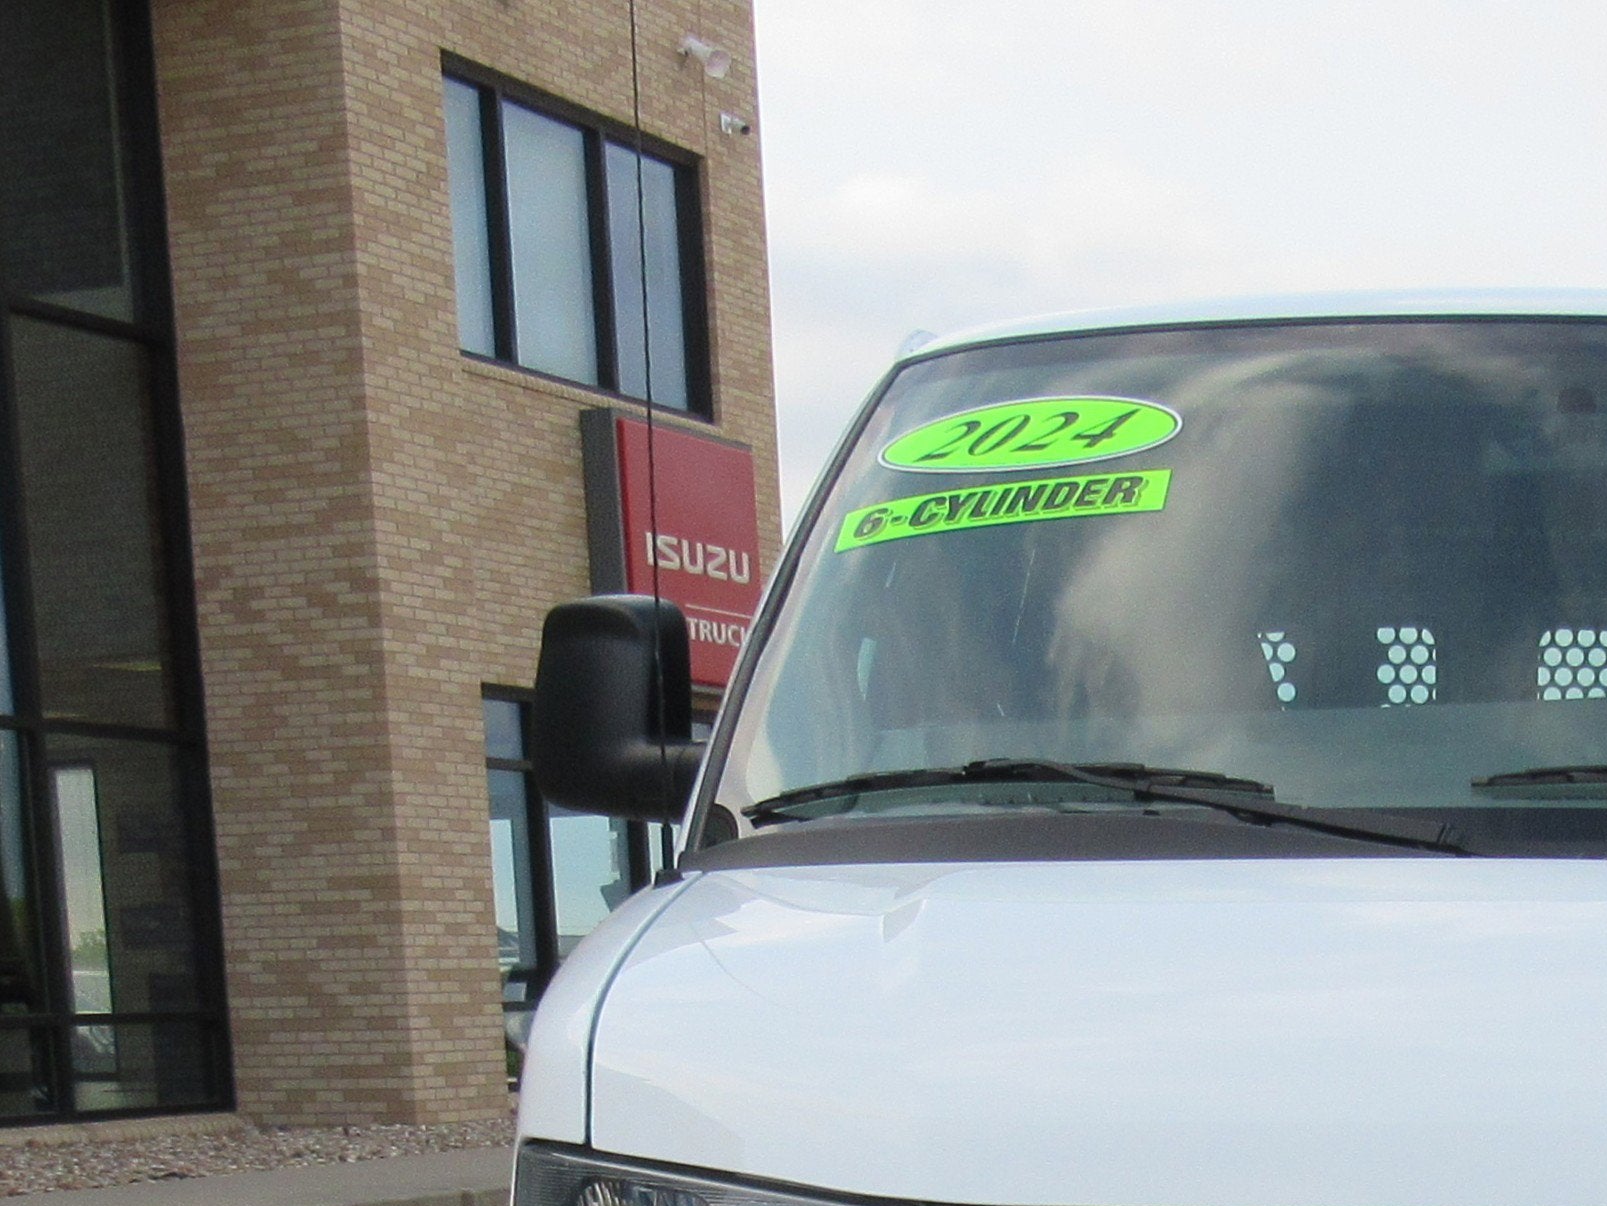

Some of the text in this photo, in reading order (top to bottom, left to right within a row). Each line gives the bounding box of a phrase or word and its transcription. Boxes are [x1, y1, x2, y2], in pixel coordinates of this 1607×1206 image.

[913, 409, 1141, 462] 2024
[853, 476, 1149, 541] 6-CYLINDER
[645, 531, 750, 584] ISUZU
